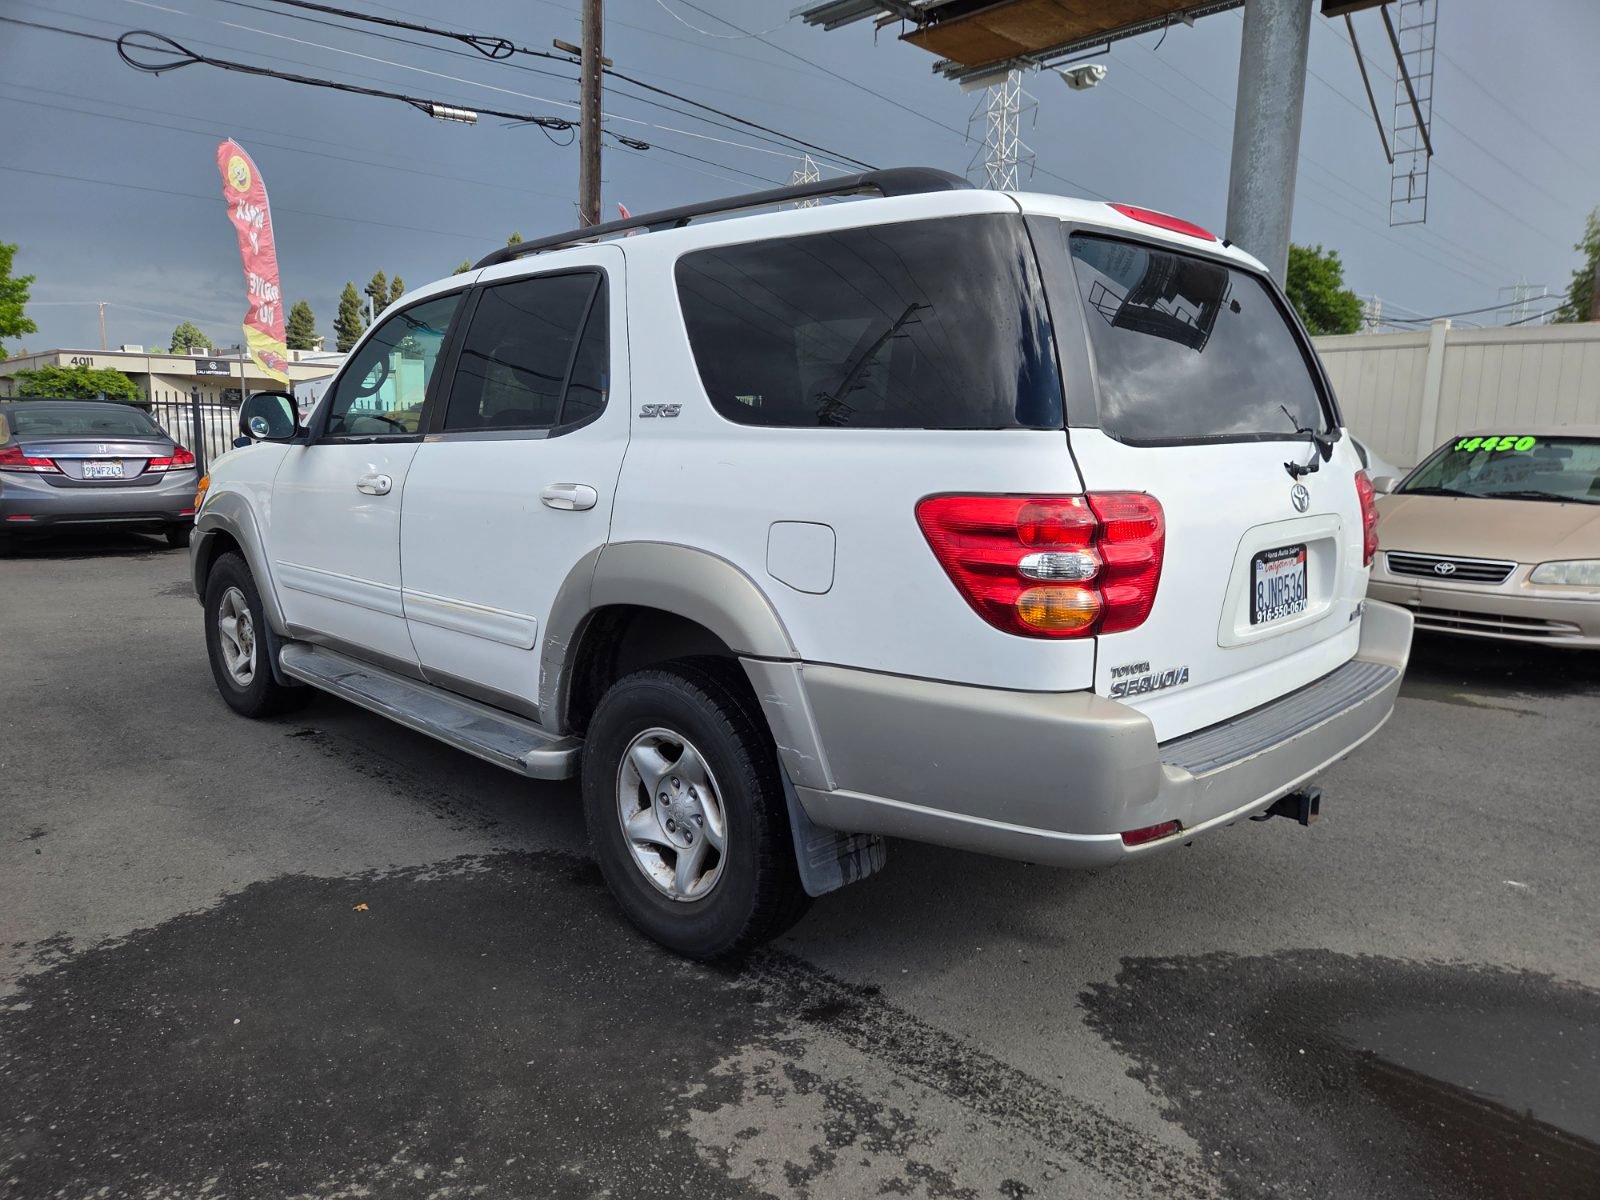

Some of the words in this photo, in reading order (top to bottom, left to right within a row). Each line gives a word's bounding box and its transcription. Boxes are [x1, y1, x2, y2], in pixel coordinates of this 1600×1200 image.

[70, 356, 94, 367] 4011
[639, 403, 683, 418] SR5
[1454, 436, 1536, 453] $4450
[1257, 569, 1303, 611] 8JNR536
[1110, 661, 1150, 679] TOYOTA
[1108, 665, 1189, 700] SEQUOIA
